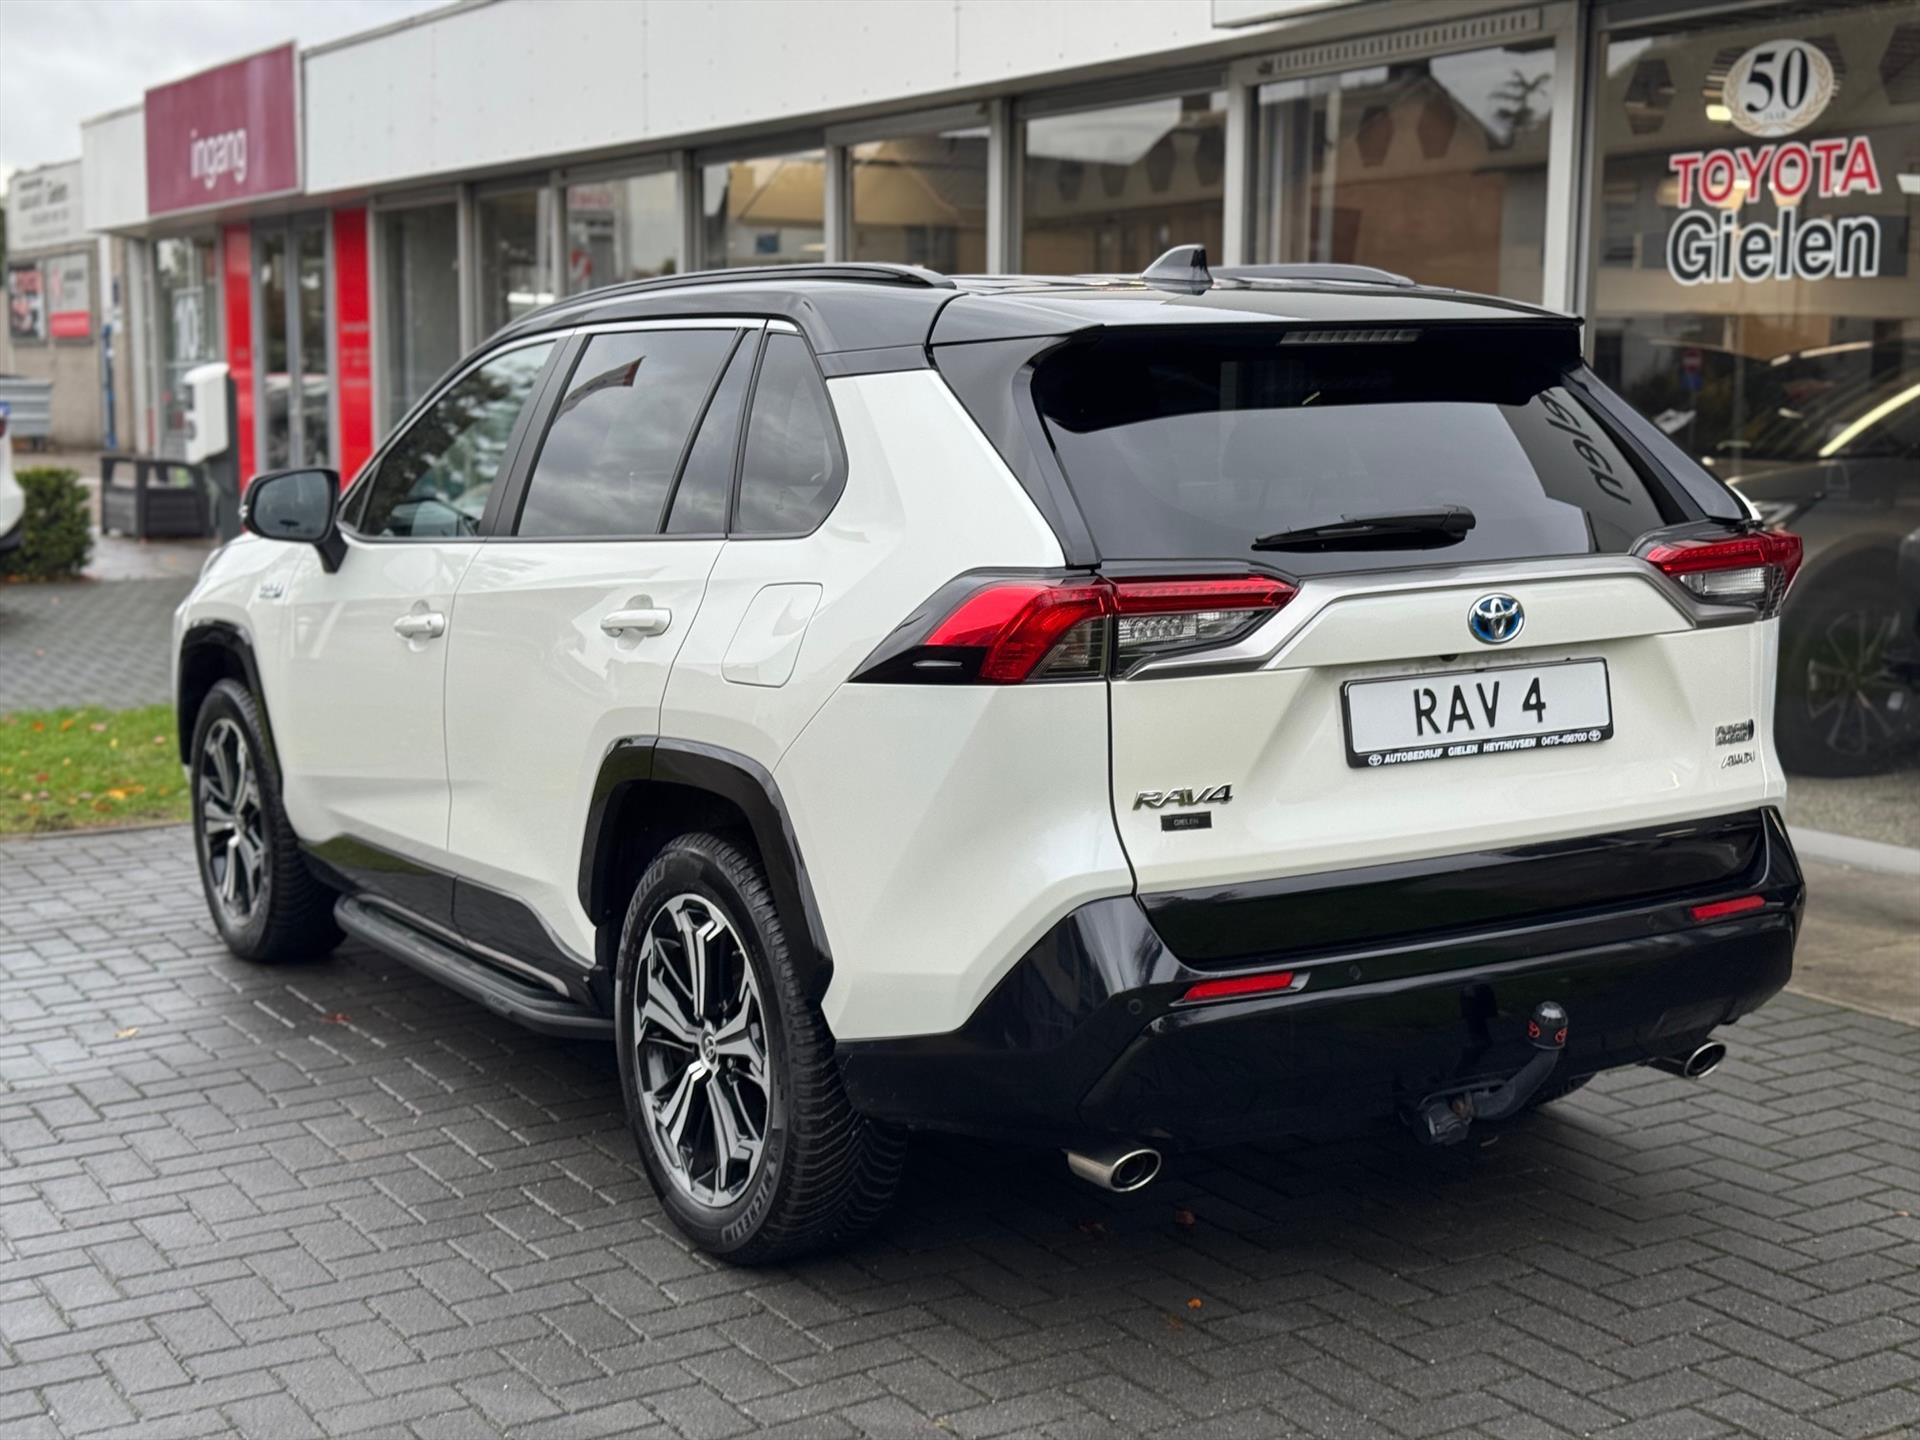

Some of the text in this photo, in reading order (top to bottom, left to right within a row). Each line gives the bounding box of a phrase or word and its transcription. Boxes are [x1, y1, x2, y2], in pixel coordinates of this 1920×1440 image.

[1745, 47, 1809, 113] 50
[190, 128, 248, 190] ingang
[1670, 137, 1880, 207] TOYOTA
[1667, 207, 1880, 284] Gielen
[1413, 677, 1547, 736] RAV 4
[1384, 747, 1443, 764] AUTOBEDRIJF
[1447, 743, 1478, 757] GIELEN
[1483, 737, 1537, 753] HEYTHUYSEN
[1132, 782, 1233, 811] RAV4
